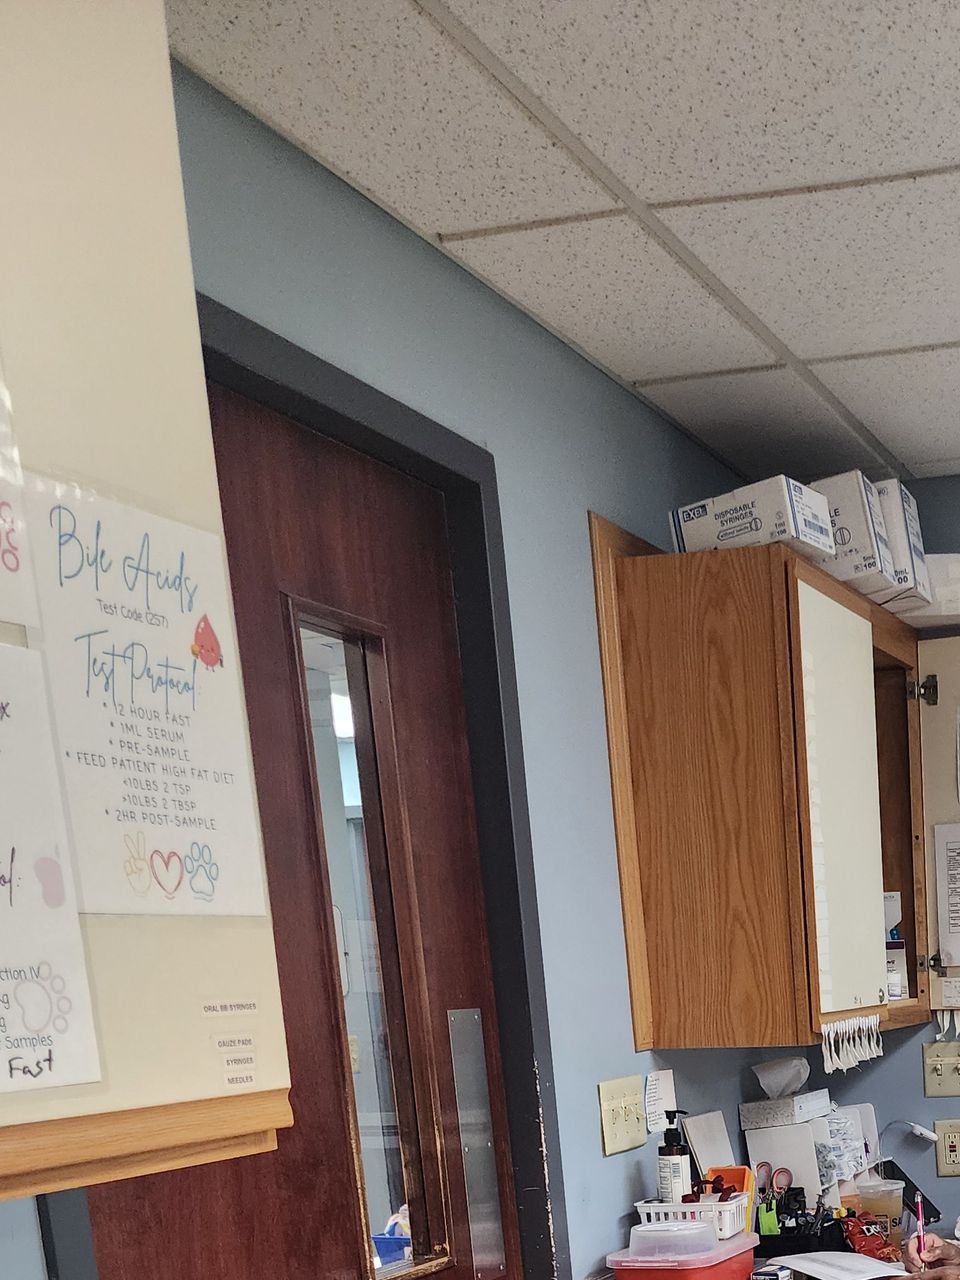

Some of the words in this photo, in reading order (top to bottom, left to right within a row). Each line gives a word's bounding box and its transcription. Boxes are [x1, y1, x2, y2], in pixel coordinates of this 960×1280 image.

[714, 501, 757, 520] DISPOSABLE
[720, 511, 754, 528] SYRINGES
[863, 560, 877, 570] 100
[96, 599, 119, 616] Test
[120, 604, 144, 625] Code
[130, 706, 161, 722] HOUR
[166, 713, 192, 728] FAST
[120, 722, 142, 737] 1ML
[146, 726, 185, 744] SERUM
[119, 739, 192, 762] PRE-SAMPLE
[76, 751, 106, 768] FEED
[111, 757, 156, 773] PATIENT
[162, 764, 186, 777] HIGH
[191, 767, 208, 781] FAT
[213, 770, 235, 784] DIET
[163, 781, 169, 794] 2
[172, 782, 191, 796] TSP
[162, 798, 169, 809] 2
[173, 799, 197, 812] TBSP
[116, 809, 137, 822] 2HR
[142, 811, 217, 831] POST-SAMPLE
[229, 1002, 257, 1012] SYRINGES
[4, 1034, 54, 1054] Samples
[8, 1049, 55, 1079] Fast
[226, 1057, 254, 1066] SYRINGES
[227, 1075, 254, 1085] NEEDLES
